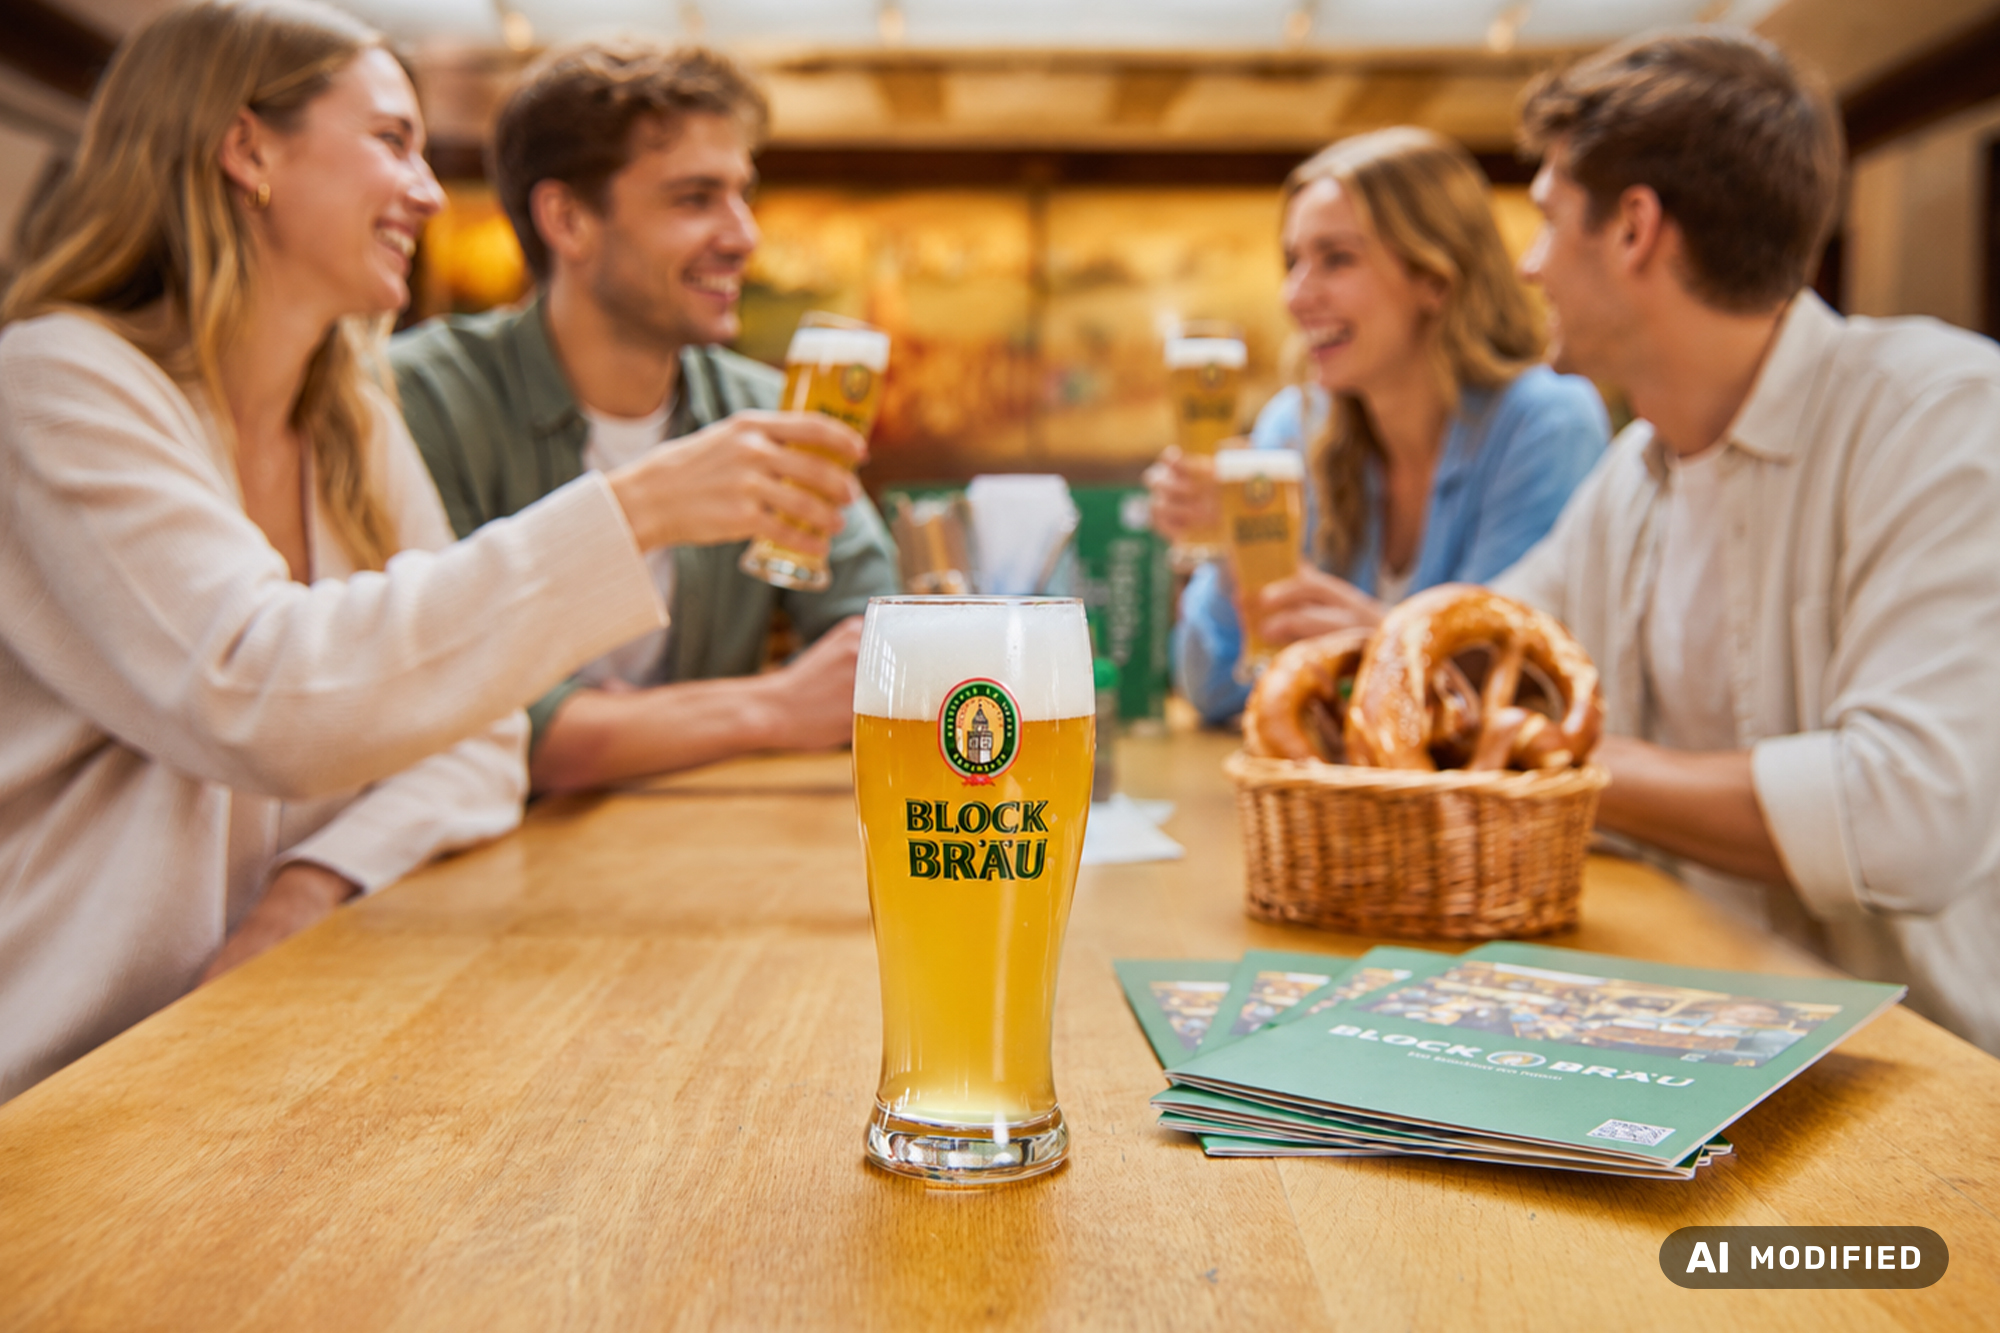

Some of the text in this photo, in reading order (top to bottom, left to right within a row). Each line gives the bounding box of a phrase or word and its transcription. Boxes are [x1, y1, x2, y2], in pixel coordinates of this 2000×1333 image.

[905, 799, 1049, 834] BLOCK
[907, 838, 1048, 881] BRÄU
[1328, 1024, 1483, 1059] BLOCK
[1548, 1061, 1695, 1087] BRÄU
